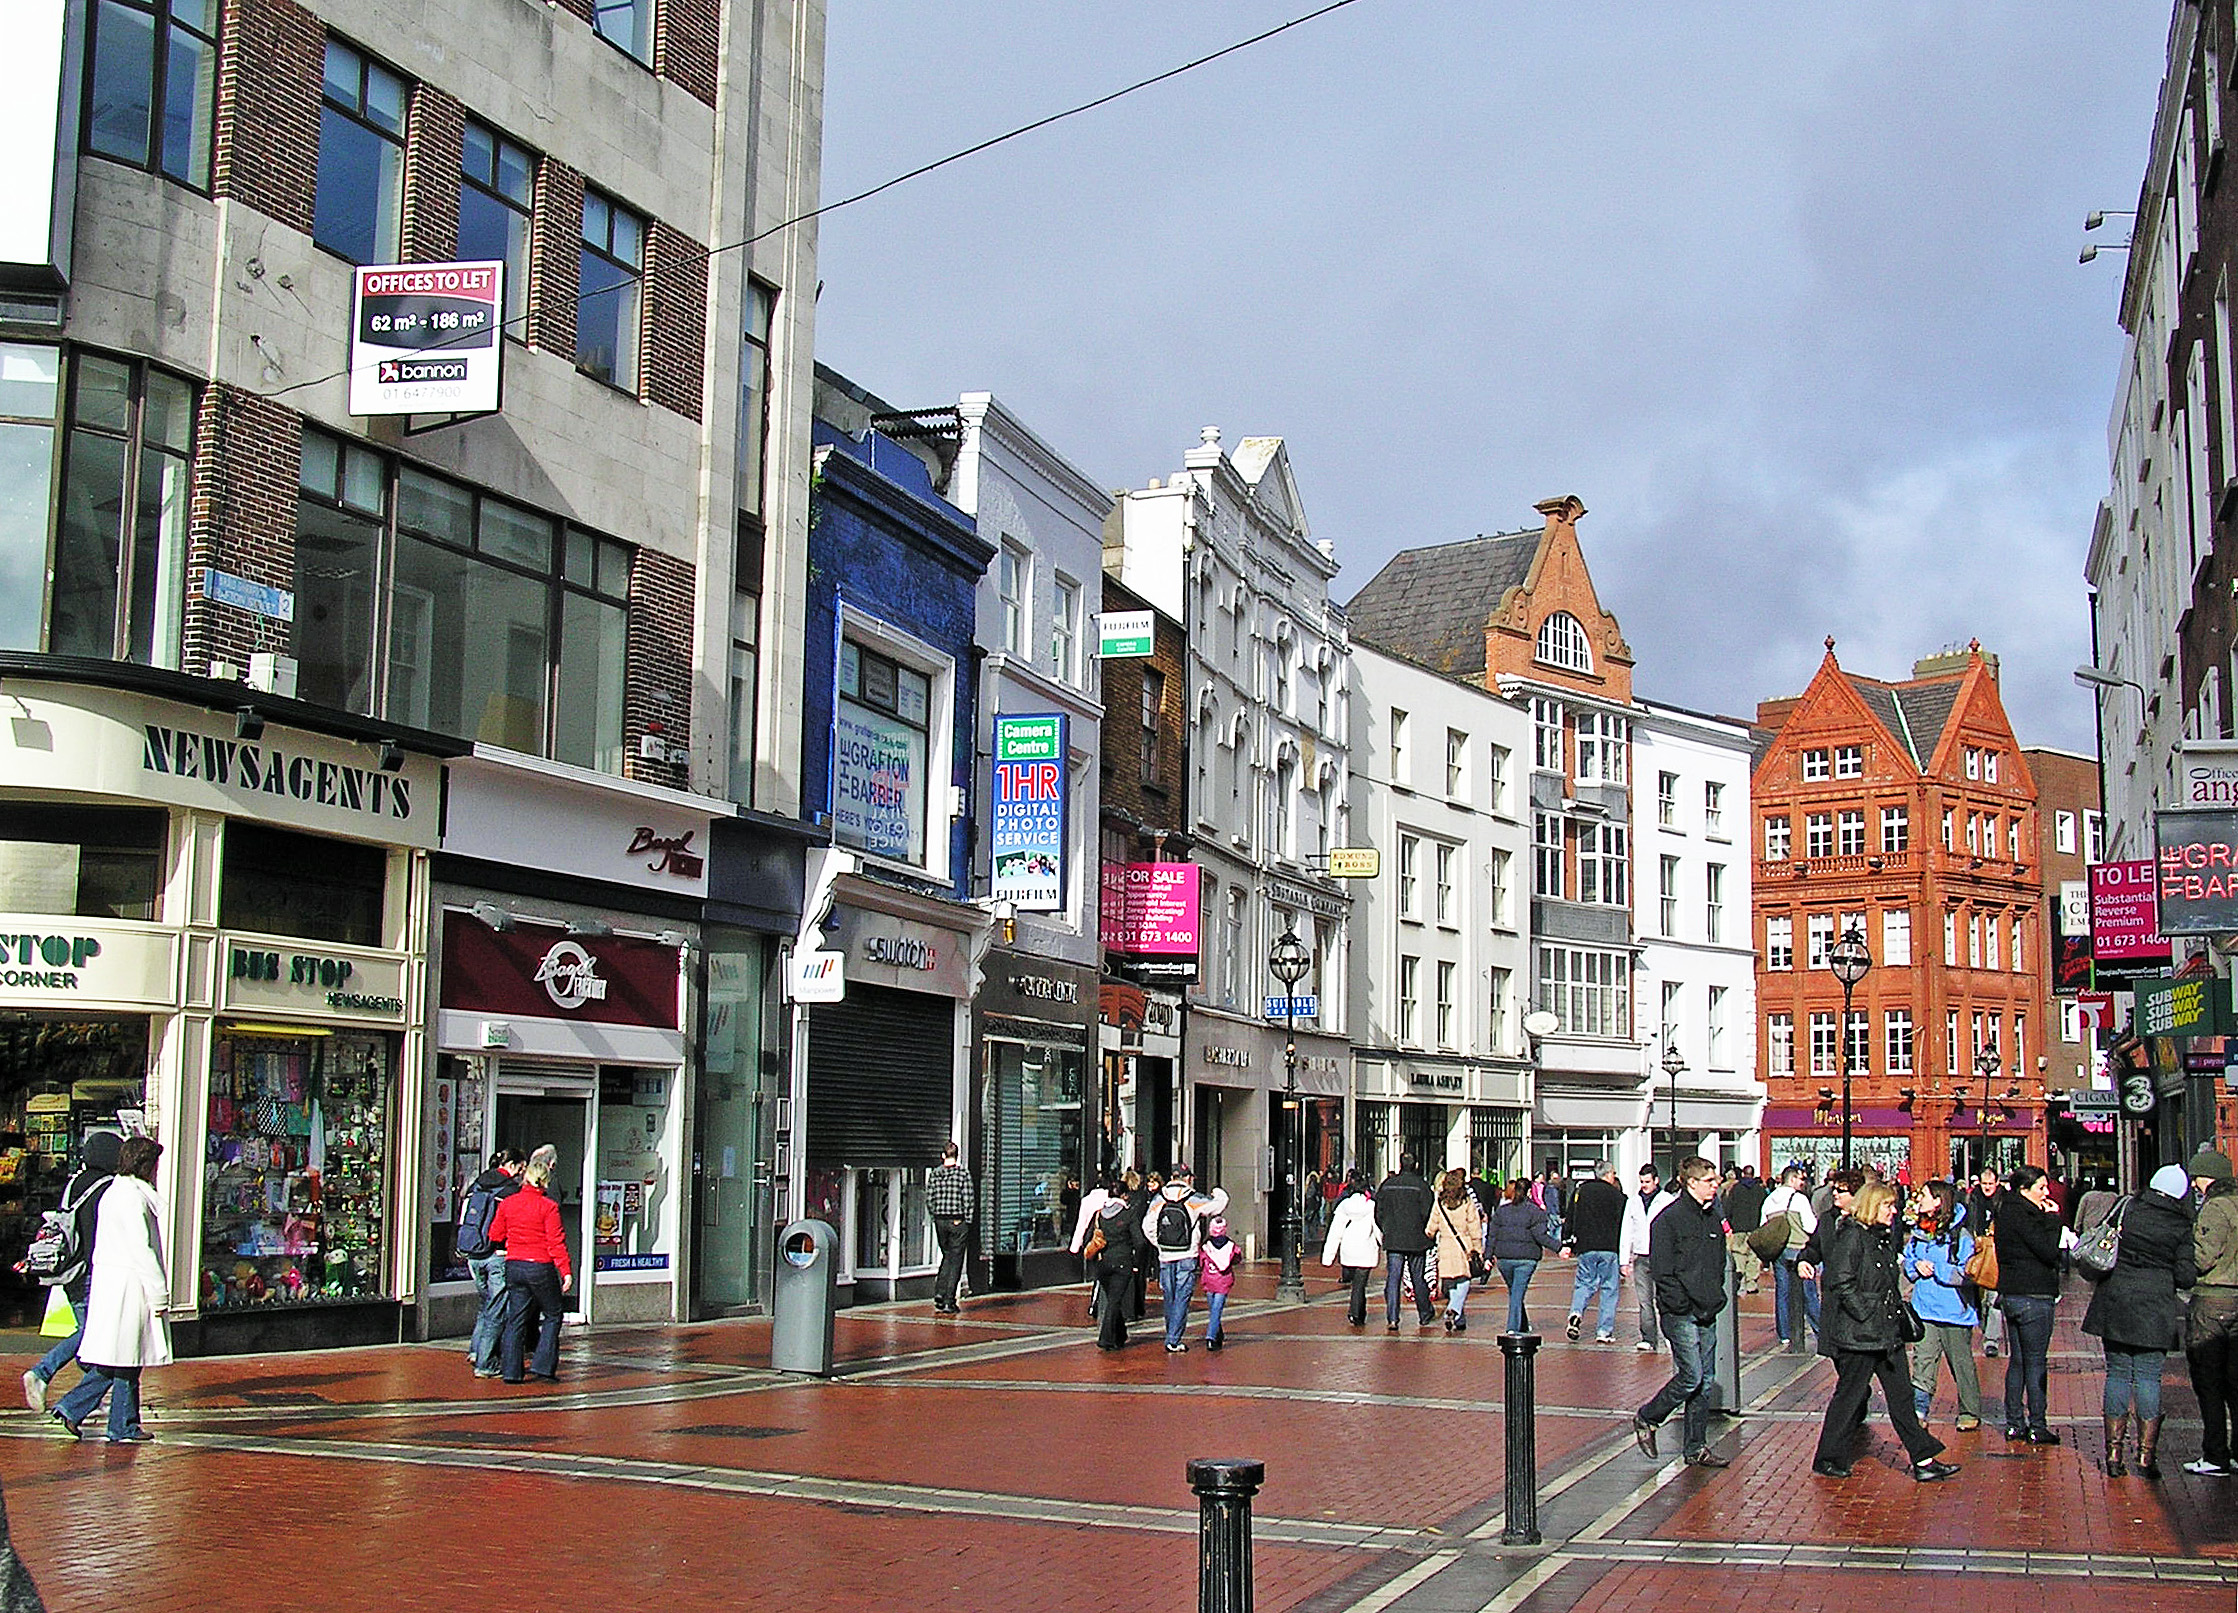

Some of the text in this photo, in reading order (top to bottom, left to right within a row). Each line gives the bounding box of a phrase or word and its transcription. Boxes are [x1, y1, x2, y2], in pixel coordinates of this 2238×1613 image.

[366, 270, 492, 293] OFFICES TO LET
[370, 314, 392, 332] 62
[430, 312, 459, 330] 186
[401, 363, 465, 379] bannon
[383, 388, 398, 400] 01
[1004, 723, 1053, 740] Camera
[1007, 740, 1050, 755] Centre
[143, 723, 411, 820] NEWSAGENTS
[840, 738, 851, 798] THE
[850, 742, 909, 782] GRAFTON
[996, 763, 1060, 802] 1HR
[850, 775, 902, 815] BARBER
[997, 803, 1058, 817] DIGITAL
[997, 817, 1058, 831] PHOTO
[996, 832, 1058, 846] SERVICE
[1153, 870, 1185, 884] SALE
[2095, 865, 2153, 886] TO LE
[2160, 845, 2184, 900] THE
[2095, 891, 2155, 905] Substantia
[2095, 906, 2137, 916] Reverse
[2095, 916, 2145, 928] Premium
[1140, 931, 1161, 942] 673
[1165, 931, 1193, 942] 1400
[2096, 937, 2111, 948] 01
[2114, 935, 2136, 946] 673
[866, 937, 929, 971] swatch
[232, 948, 354, 988] BUS STOP
[534, 956, 599, 997] Bagel
[0, 970, 78, 989] ORNER
[325, 991, 404, 1012] NEWSAGENTS
[2146, 982, 2204, 1008] SUBWAY
[2146, 994, 2205, 1020] SUBWAY
[2146, 1007, 2205, 1034] SUBWAY
[2124, 1075, 2155, 1113] 3
[610, 1258, 631, 1268] FRESH
